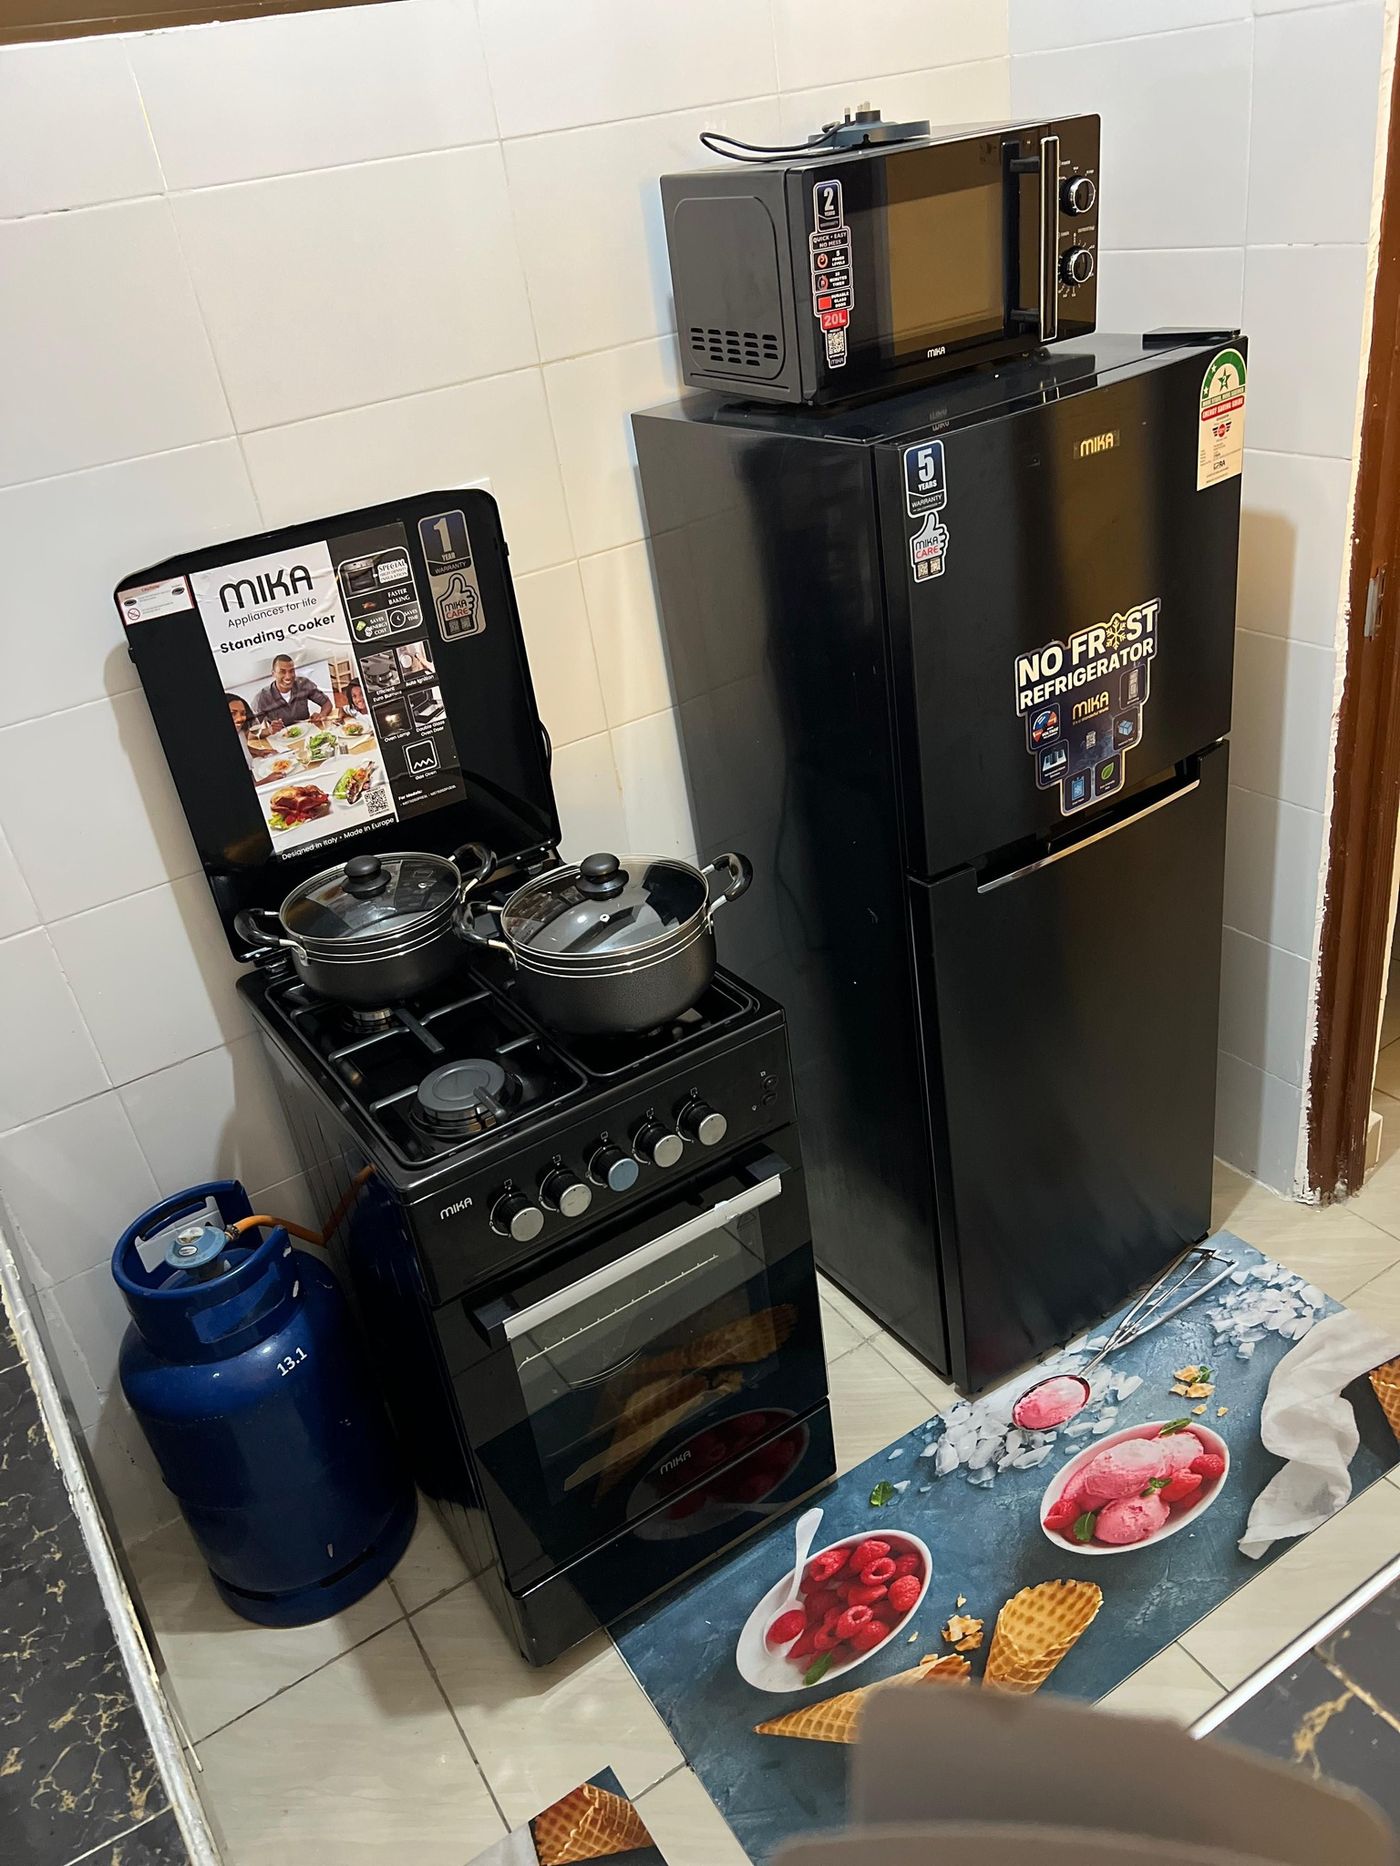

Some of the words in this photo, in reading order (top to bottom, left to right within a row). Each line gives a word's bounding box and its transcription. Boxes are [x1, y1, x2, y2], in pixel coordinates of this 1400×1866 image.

[824, 187, 834, 211] 2
[813, 235, 830, 243] QUICK
[828, 239, 842, 247] MESS
[824, 313, 846, 327] 20L
[927, 346, 946, 358] MIKA
[1080, 432, 1114, 457] MIKA
[918, 447, 935, 482] 5
[918, 479, 938, 491] YEARS
[911, 494, 943, 508] WARRANTY
[433, 517, 452, 553] 1
[915, 536, 939, 550] MIKA
[441, 552, 456, 562] YEAR
[915, 545, 939, 559] CARE
[379, 560, 407, 572] SPECIAL
[435, 561, 466, 574] WARRANTY
[219, 565, 314, 613] MIKA
[388, 588, 408, 598] FASTER
[388, 595, 410, 605] BAKING
[444, 599, 467, 612] MIKA
[228, 606, 284, 628] Appliances
[286, 601, 301, 612] for
[302, 597, 317, 608] life
[446, 608, 468, 619] CARE
[369, 621, 388, 630] ENERGY
[370, 616, 384, 624] SAVES
[220, 629, 285, 653] Standing
[288, 614, 335, 635] Cooker
[1018, 646, 1063, 687] NO
[1020, 637, 1154, 710] REFRIGERATOR
[1072, 691, 1109, 721] MIKA
[281, 844, 315, 861] Designed
[315, 841, 322, 849] in
[323, 836, 338, 848] Italy
[343, 827, 363, 840] Made
[364, 825, 371, 833] in
[371, 817, 394, 832] Europe
[440, 1197, 473, 1220] MIKA
[276, 1347, 308, 1377] 13.1
[660, 1450, 692, 1475] MIKA
